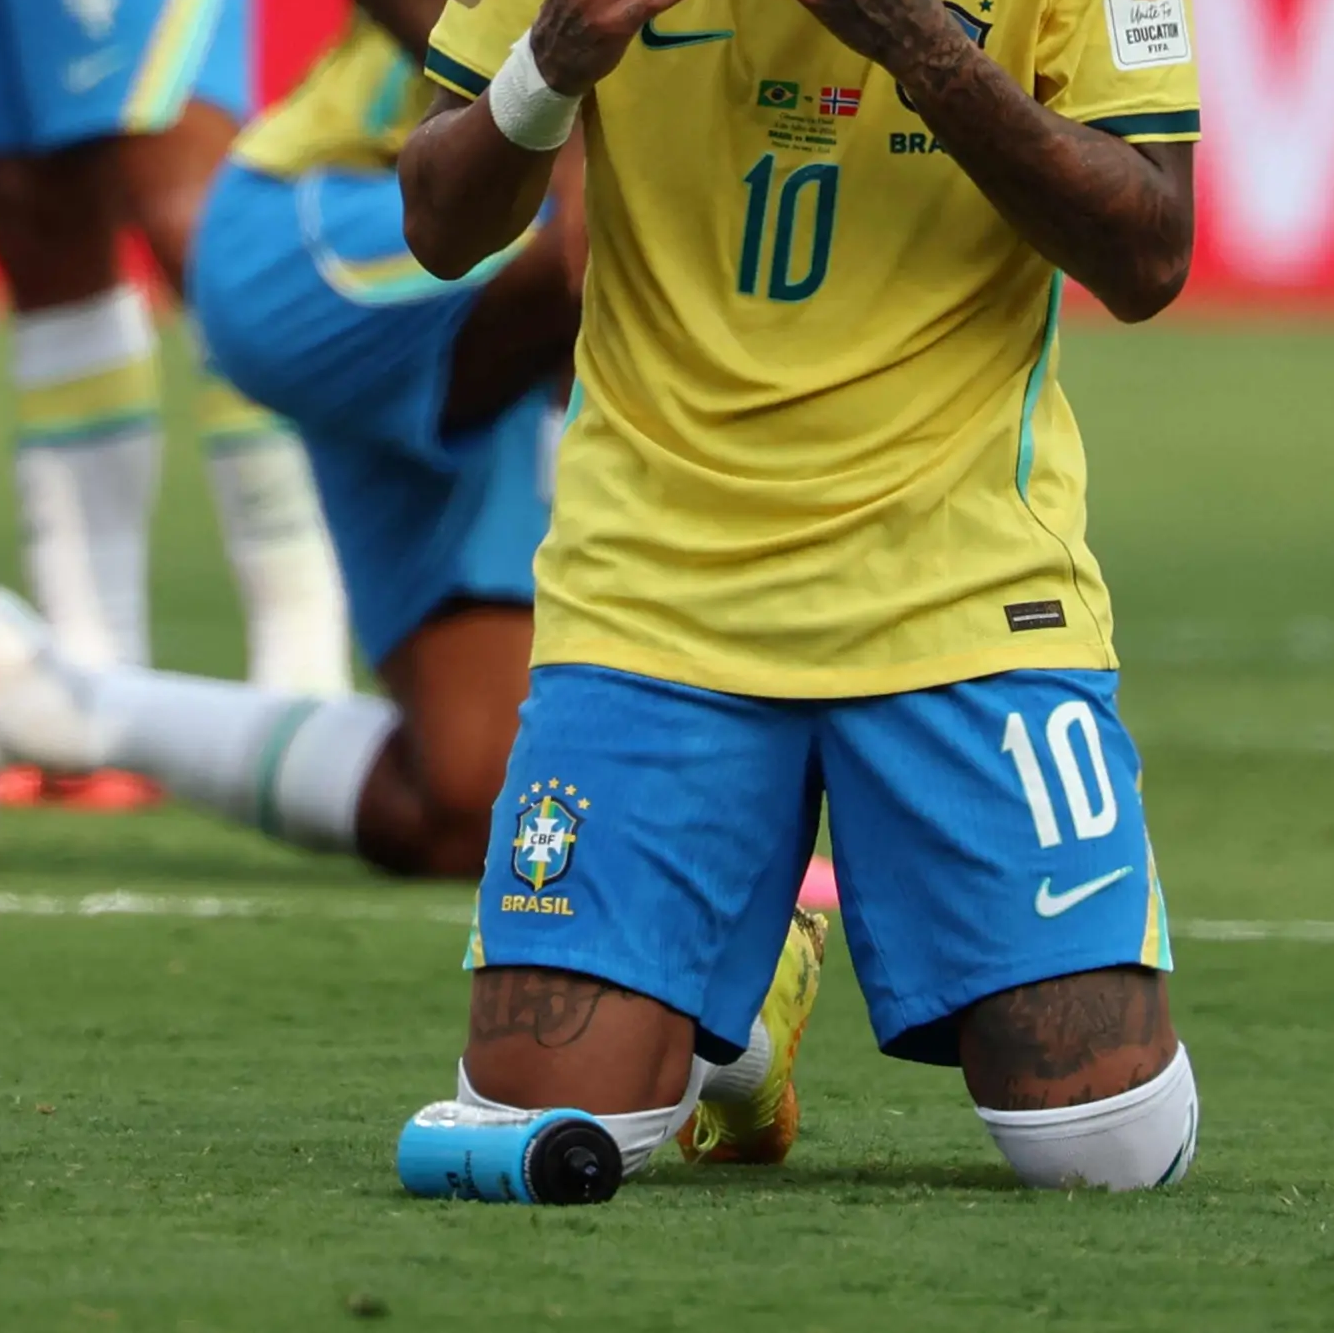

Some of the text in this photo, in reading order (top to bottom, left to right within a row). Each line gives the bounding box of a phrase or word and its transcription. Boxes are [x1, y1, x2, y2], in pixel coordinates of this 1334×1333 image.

[1148, 43, 1169, 54] FIFA
[889, 132, 948, 154] BRA
[737, 153, 839, 303] 10
[1001, 700, 1117, 850] 10
[530, 833, 556, 845] CBF
[500, 895, 574, 916] BRASIL
